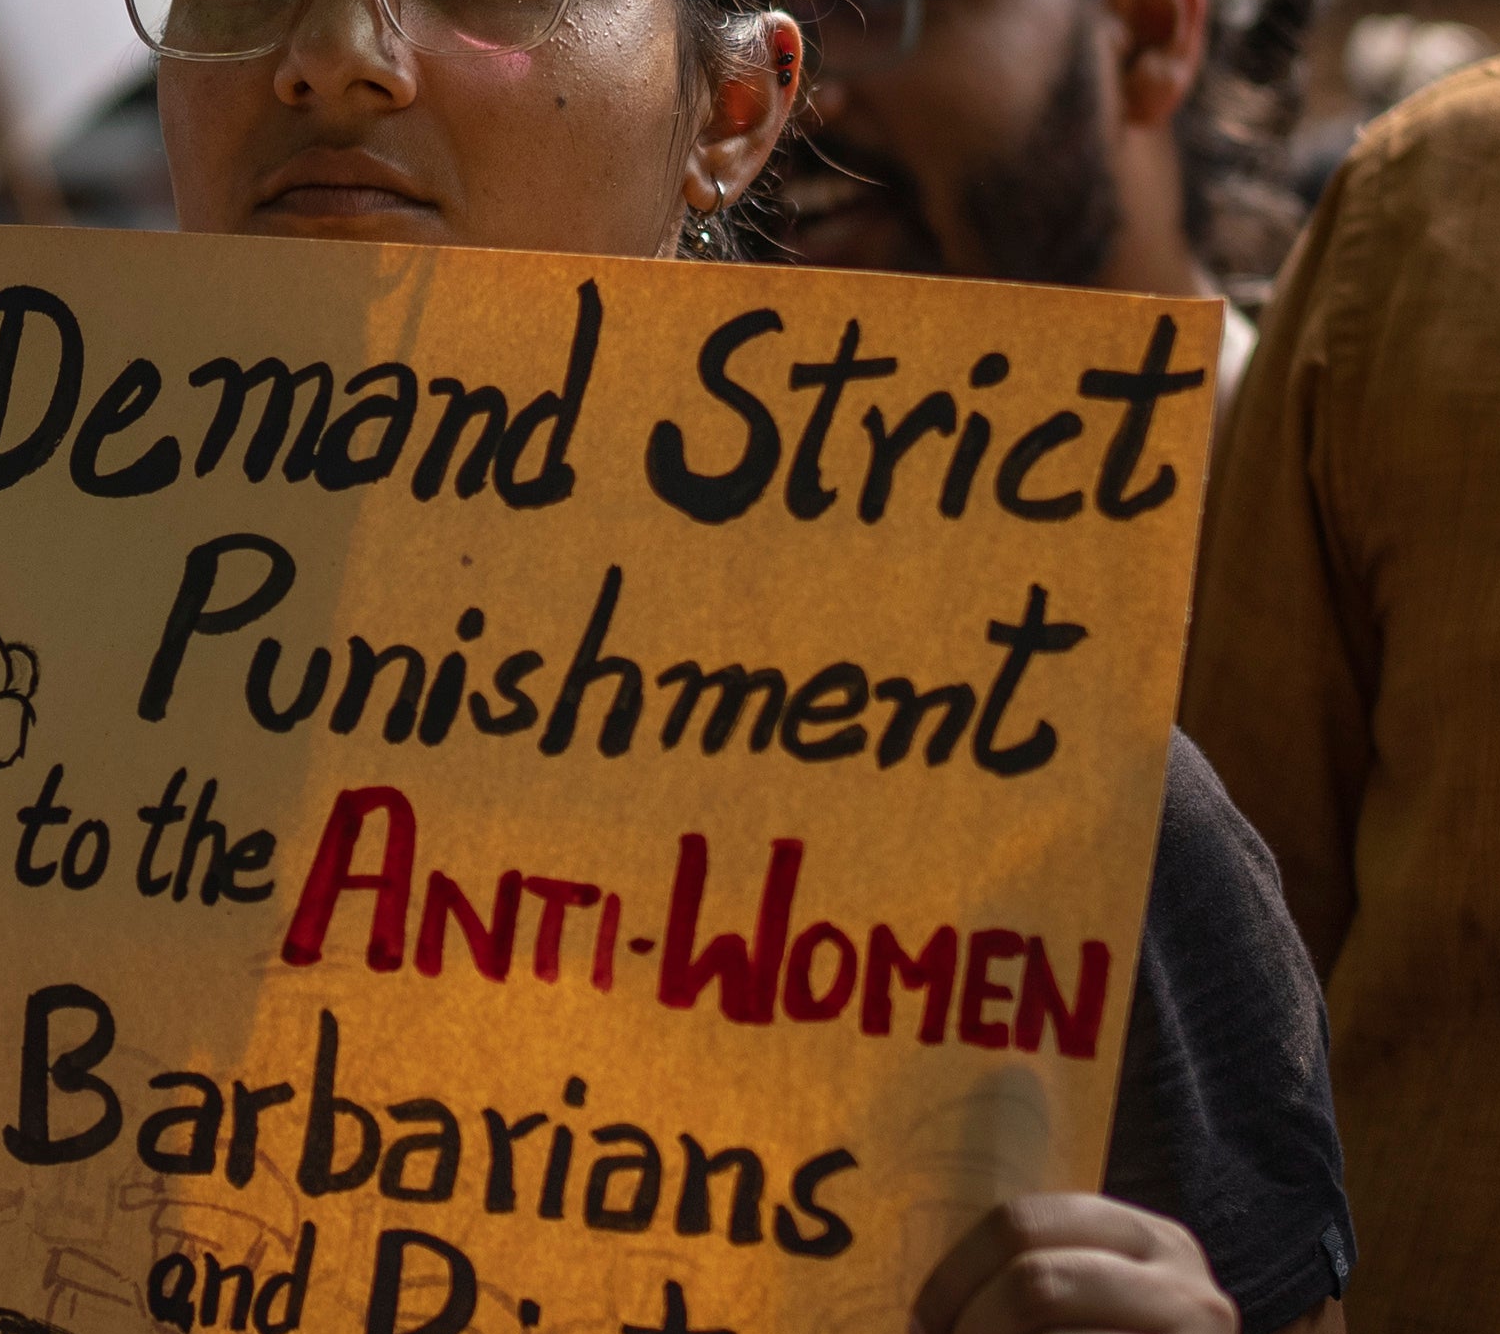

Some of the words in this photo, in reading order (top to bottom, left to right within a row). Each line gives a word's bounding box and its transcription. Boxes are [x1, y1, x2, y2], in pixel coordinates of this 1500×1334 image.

[646, 306, 1206, 524] Strict
[136, 532, 1091, 774] Punishment
[14, 763, 109, 892] to
[138, 765, 277, 907] the
[280, 784, 1112, 1059] ANTI-WOMEN
[2, 983, 862, 1259] Barbarians
